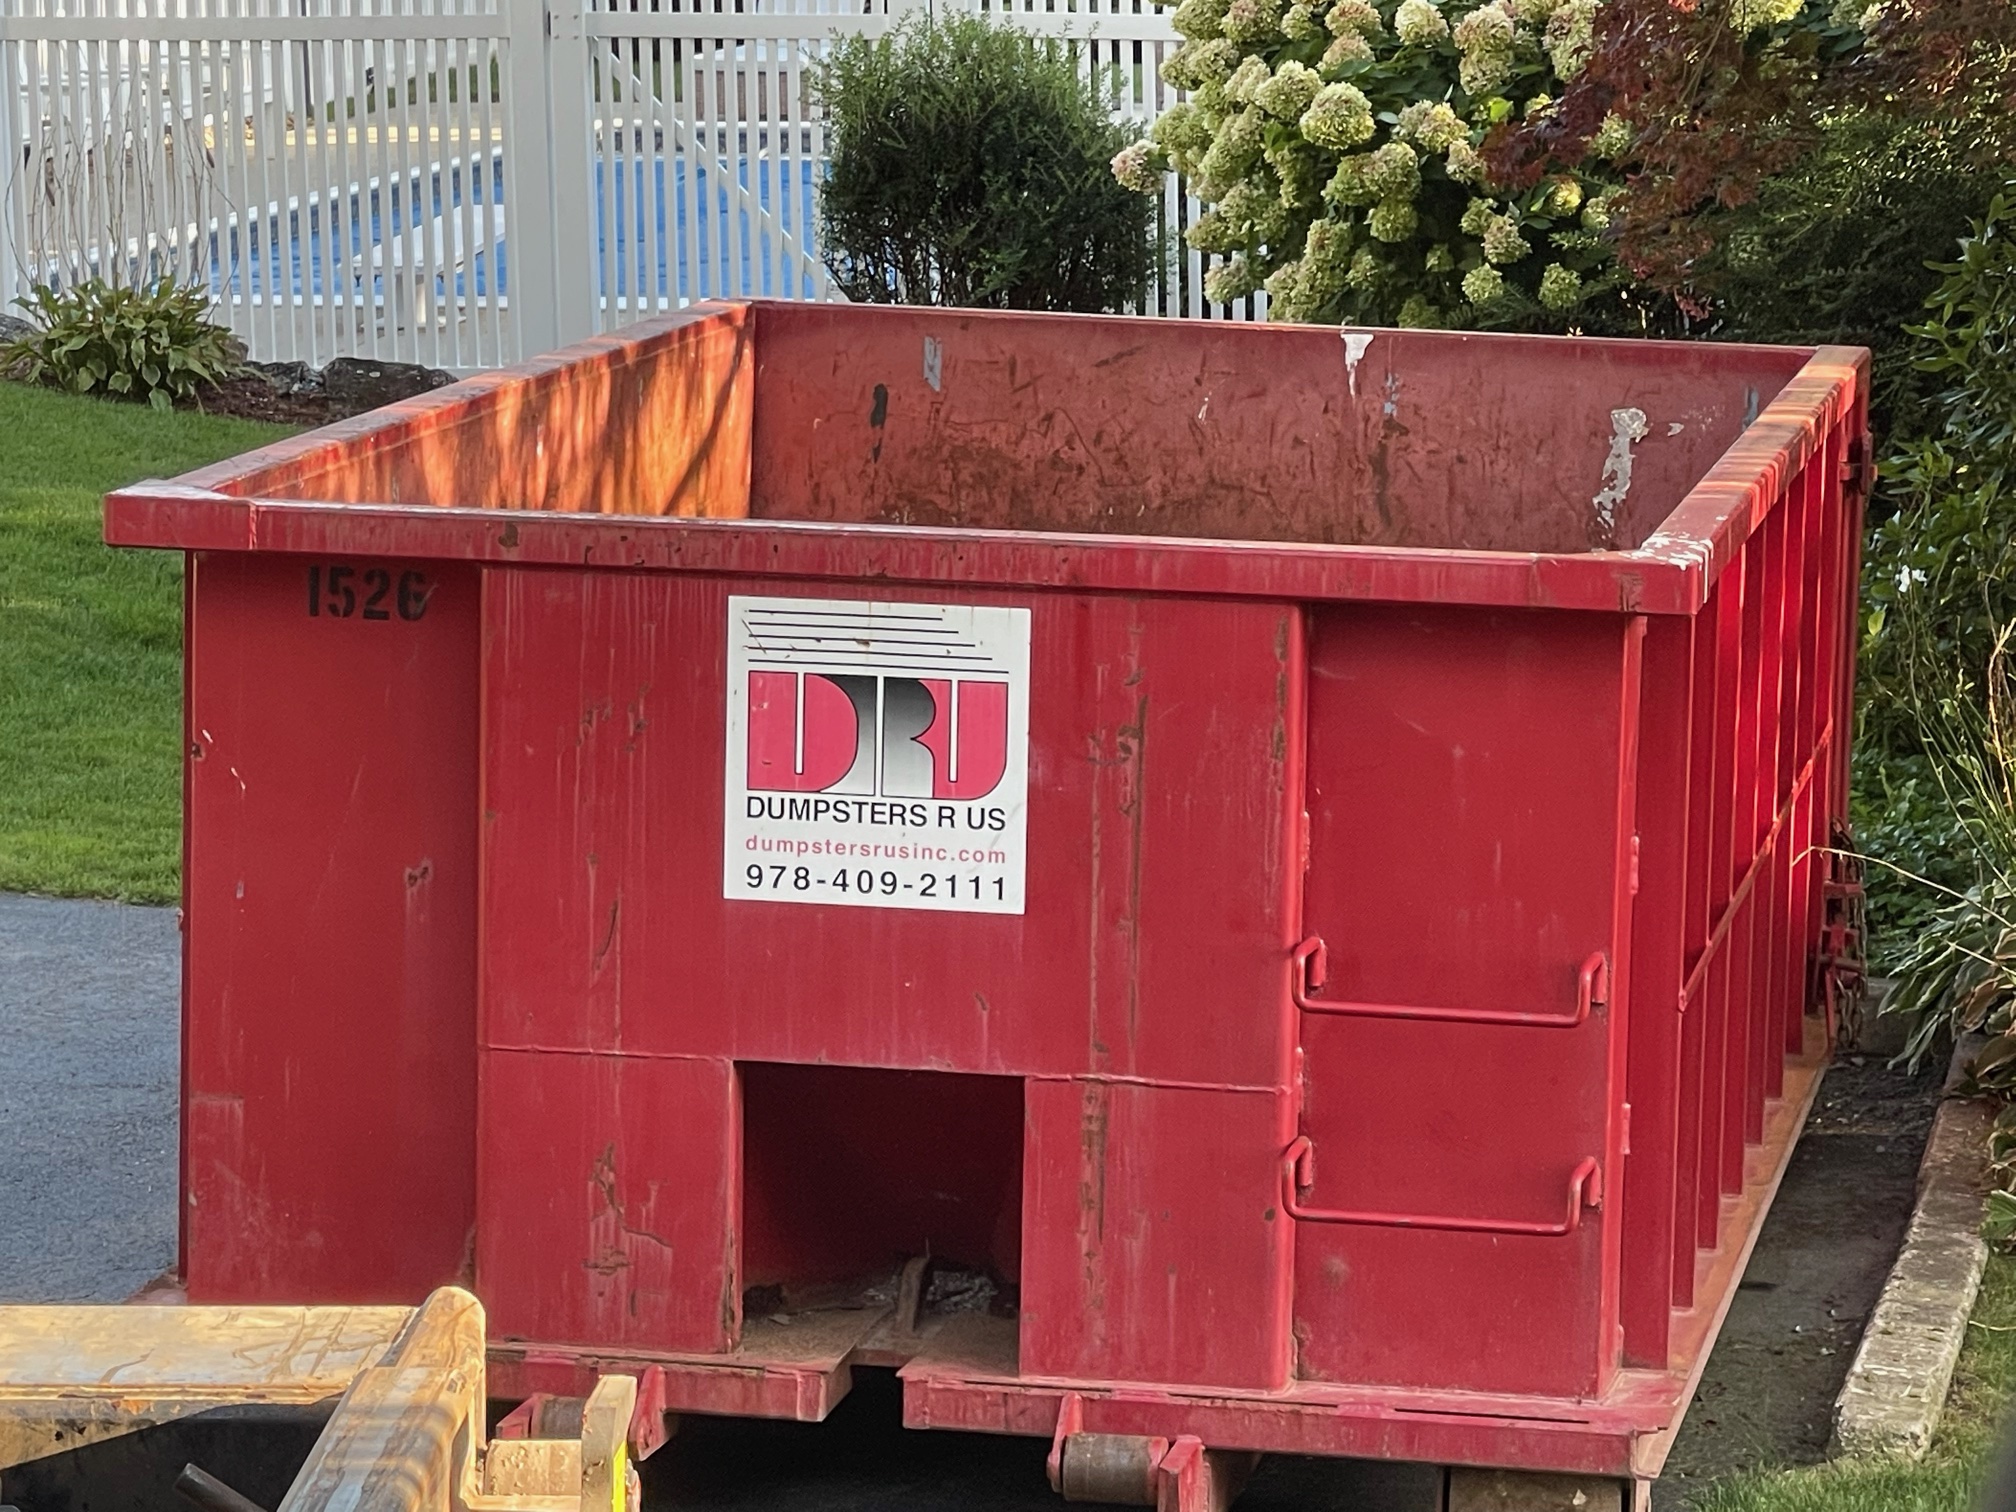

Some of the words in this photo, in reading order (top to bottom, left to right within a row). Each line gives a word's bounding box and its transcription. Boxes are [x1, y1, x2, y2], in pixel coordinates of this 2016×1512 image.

[309, 565, 428, 621] 1526
[746, 796, 927, 827] DUMPSTERS
[938, 806, 956, 828] R
[967, 807, 1006, 831] US
[745, 835, 1006, 863] dumpstersrusinc.com
[746, 864, 1005, 900] 978-409-2111
